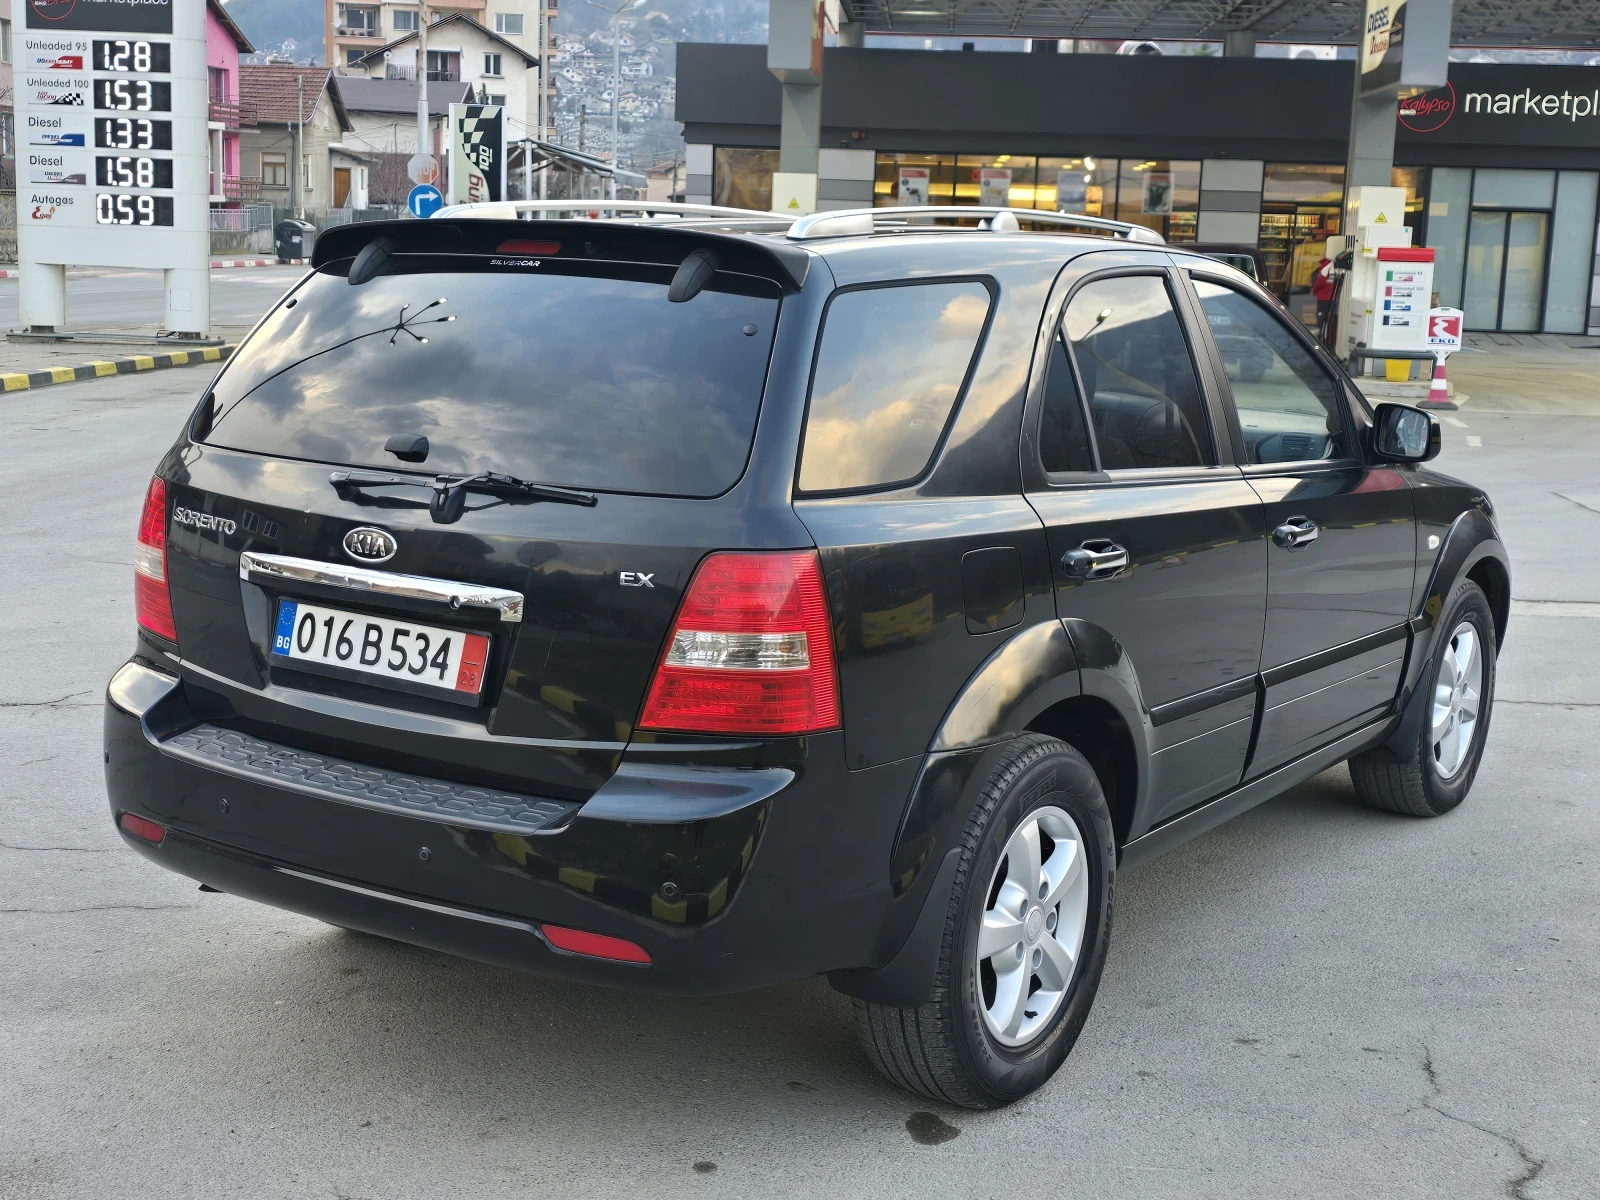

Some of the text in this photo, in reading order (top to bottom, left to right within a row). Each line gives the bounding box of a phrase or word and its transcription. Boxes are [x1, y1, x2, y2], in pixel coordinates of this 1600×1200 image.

[26, 40, 87, 51] Unleaded 95
[104, 40, 151, 72] 1.28
[26, 78, 89, 88] Unleaded 100
[105, 79, 152, 112] 1.53
[1400, 92, 1451, 116] Kalypso
[1464, 87, 1600, 122] marketpl
[28, 116, 62, 128] Diesel
[106, 118, 153, 149] 1.33
[29, 155, 63, 166] Diesel
[479, 145, 490, 171] 100
[107, 156, 154, 188] 1.58
[31, 193, 74, 206] Autogas
[96, 193, 155, 225] 0.59
[174, 506, 236, 535] SORENTO
[350, 533, 386, 557] KIA
[620, 571, 655, 588] EX
[276, 635, 291, 649] BG
[296, 611, 452, 681] 016B534
